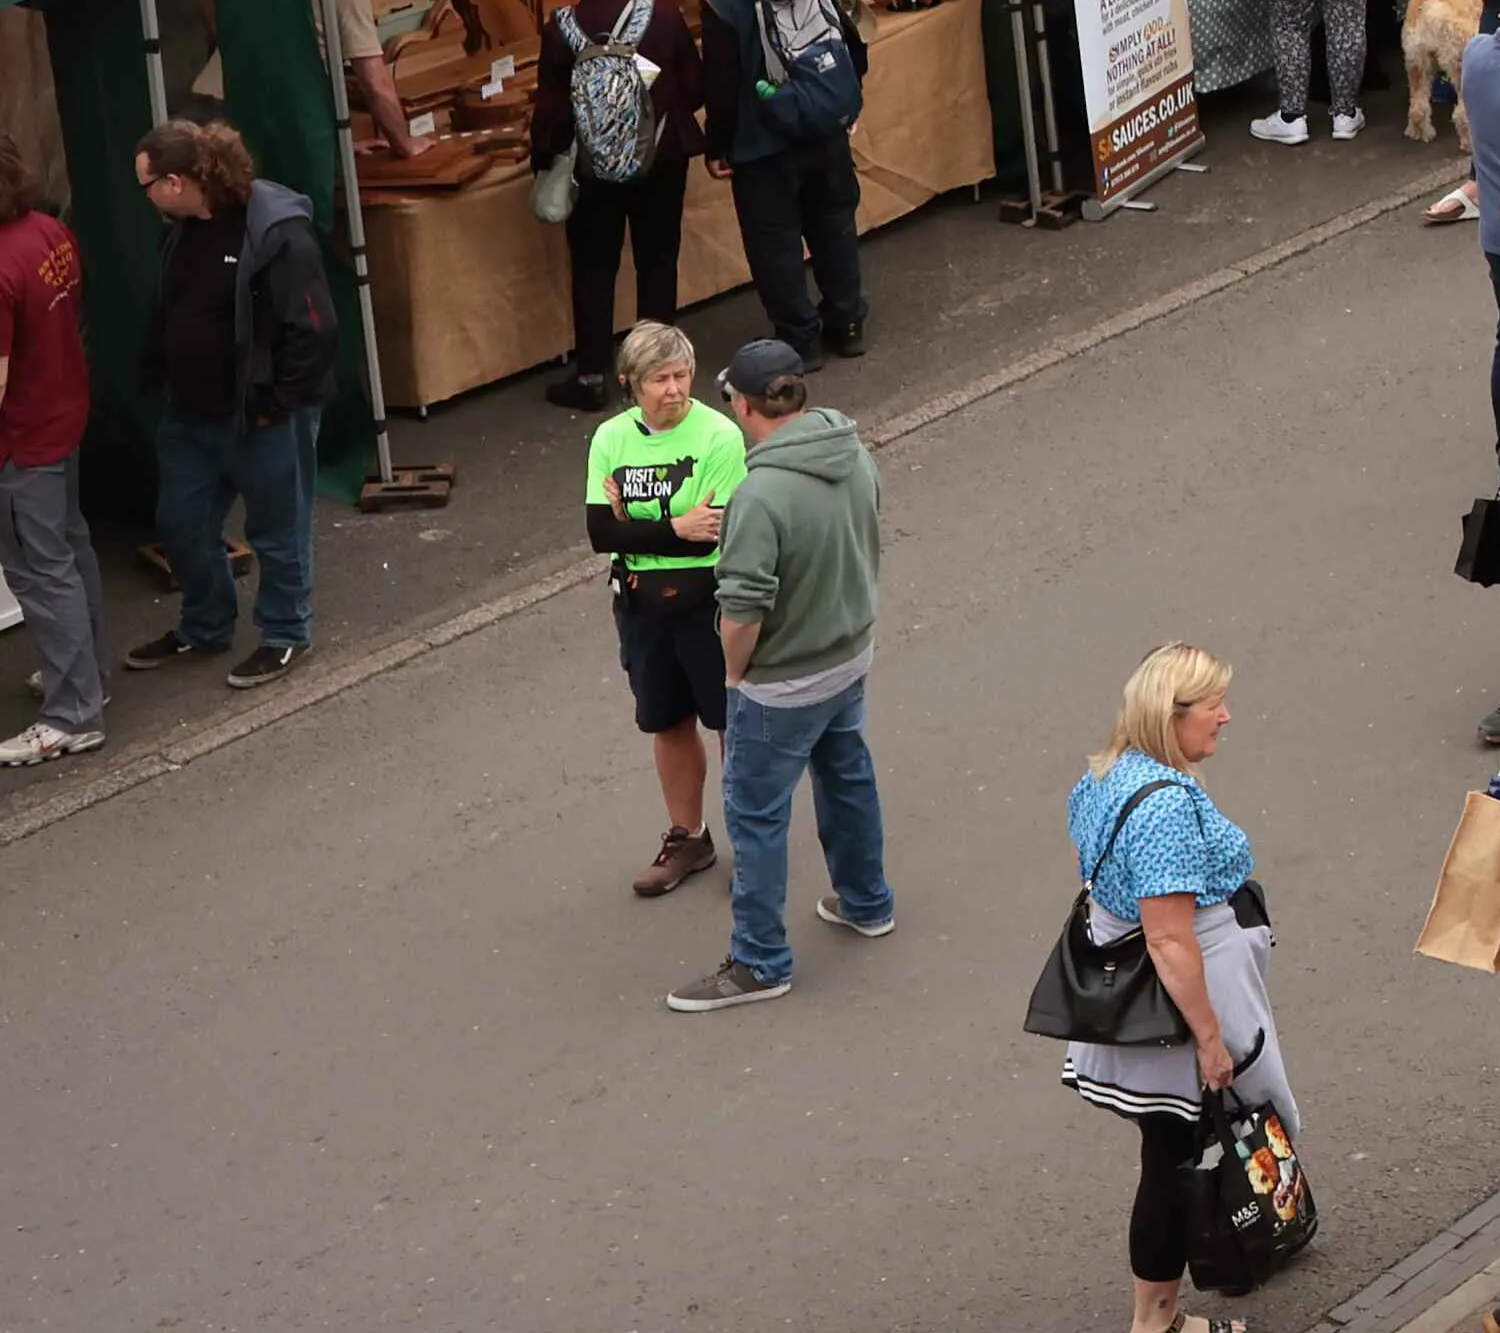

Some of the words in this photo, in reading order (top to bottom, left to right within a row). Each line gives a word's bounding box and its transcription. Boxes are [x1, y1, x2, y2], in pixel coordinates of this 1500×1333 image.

[1106, 47, 1144, 84] NOTHING
[1145, 41, 1156, 60] AT
[1156, 28, 1176, 51] ALL!
[1116, 86, 1139, 108] instant
[625, 468, 654, 483] VISIT
[623, 481, 671, 497] MALTON
[1231, 1201, 1259, 1227] M&S
